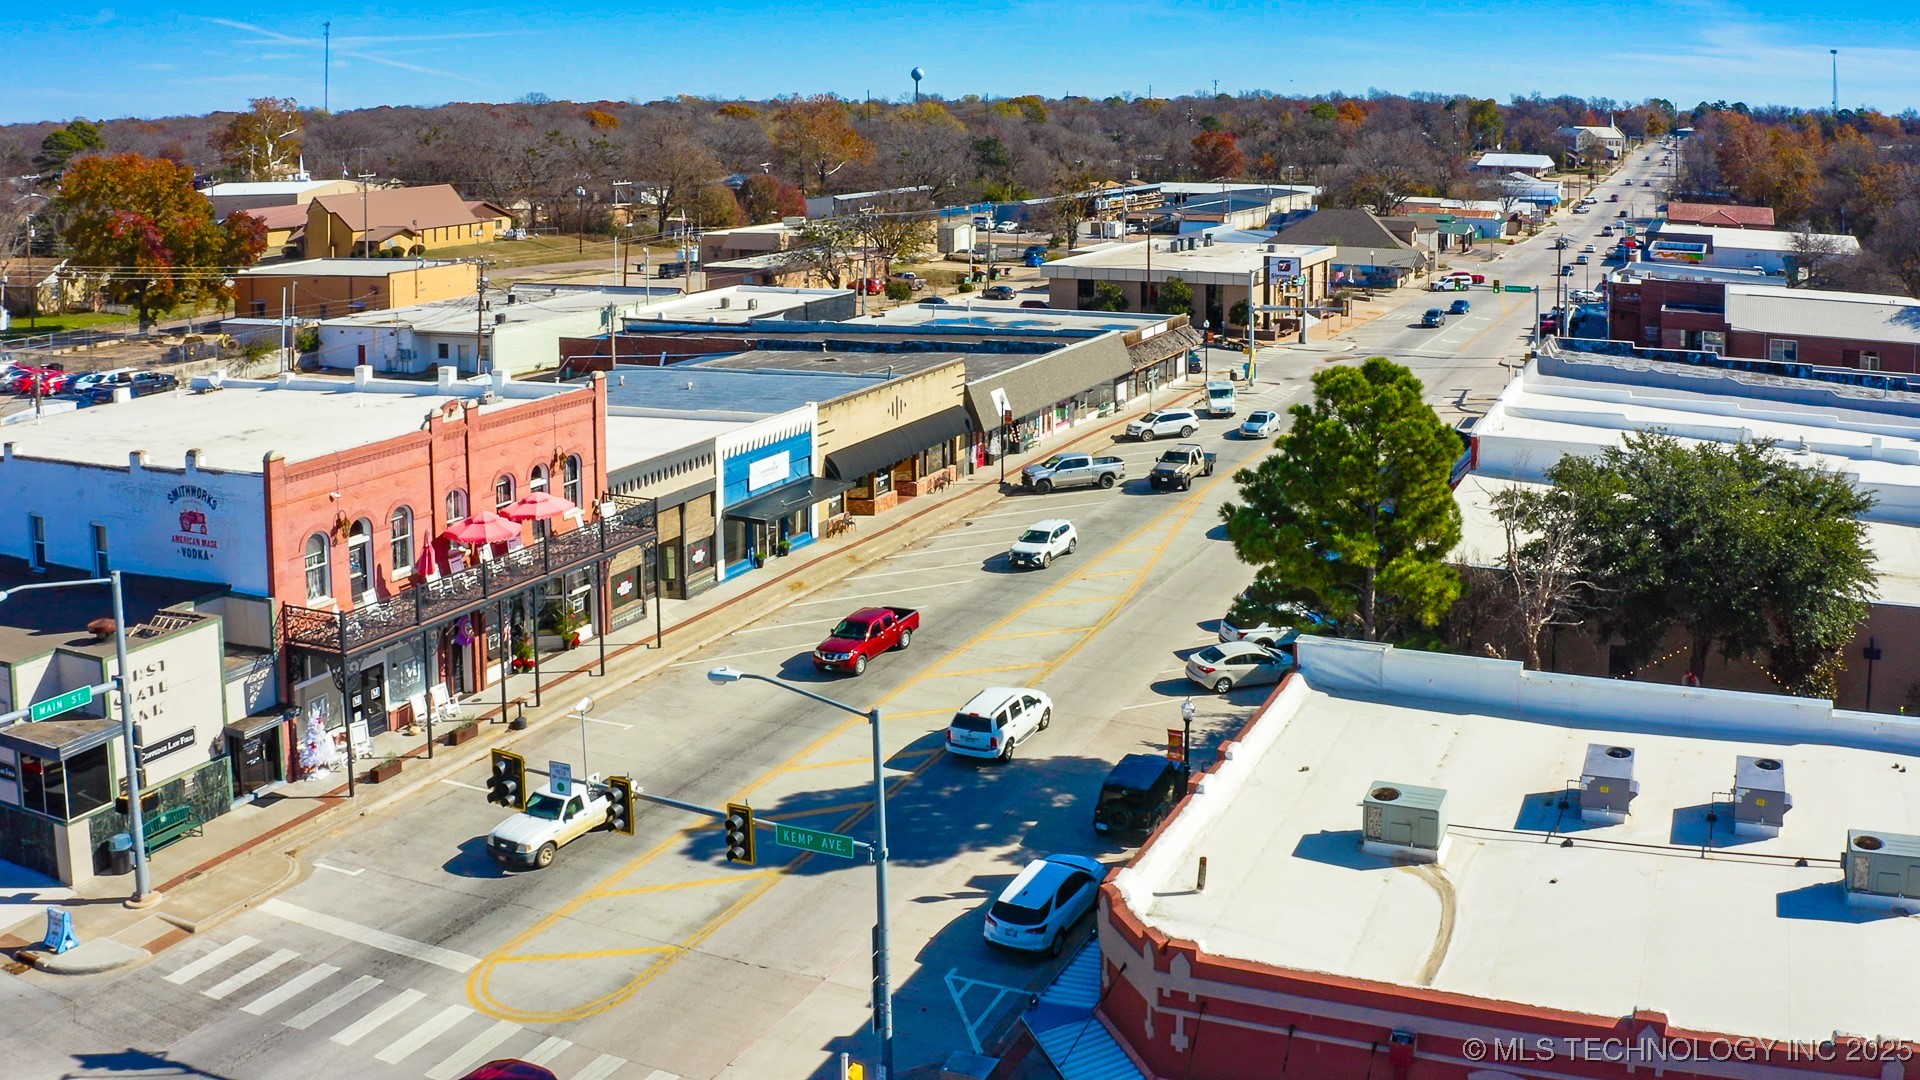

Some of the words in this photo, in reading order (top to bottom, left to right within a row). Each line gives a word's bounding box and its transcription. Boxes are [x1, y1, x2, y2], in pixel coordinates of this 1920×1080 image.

[167, 484, 217, 510] SMITHWORKS
[172, 534, 200, 547] AMERICAN
[201, 539, 217, 549] MADE
[181, 547, 209, 560] VODKA
[39, 701, 63, 715] MAIN
[71, 693, 84, 704] ST.
[783, 830, 813, 845] KEMP
[821, 837, 846, 852] AVE.
